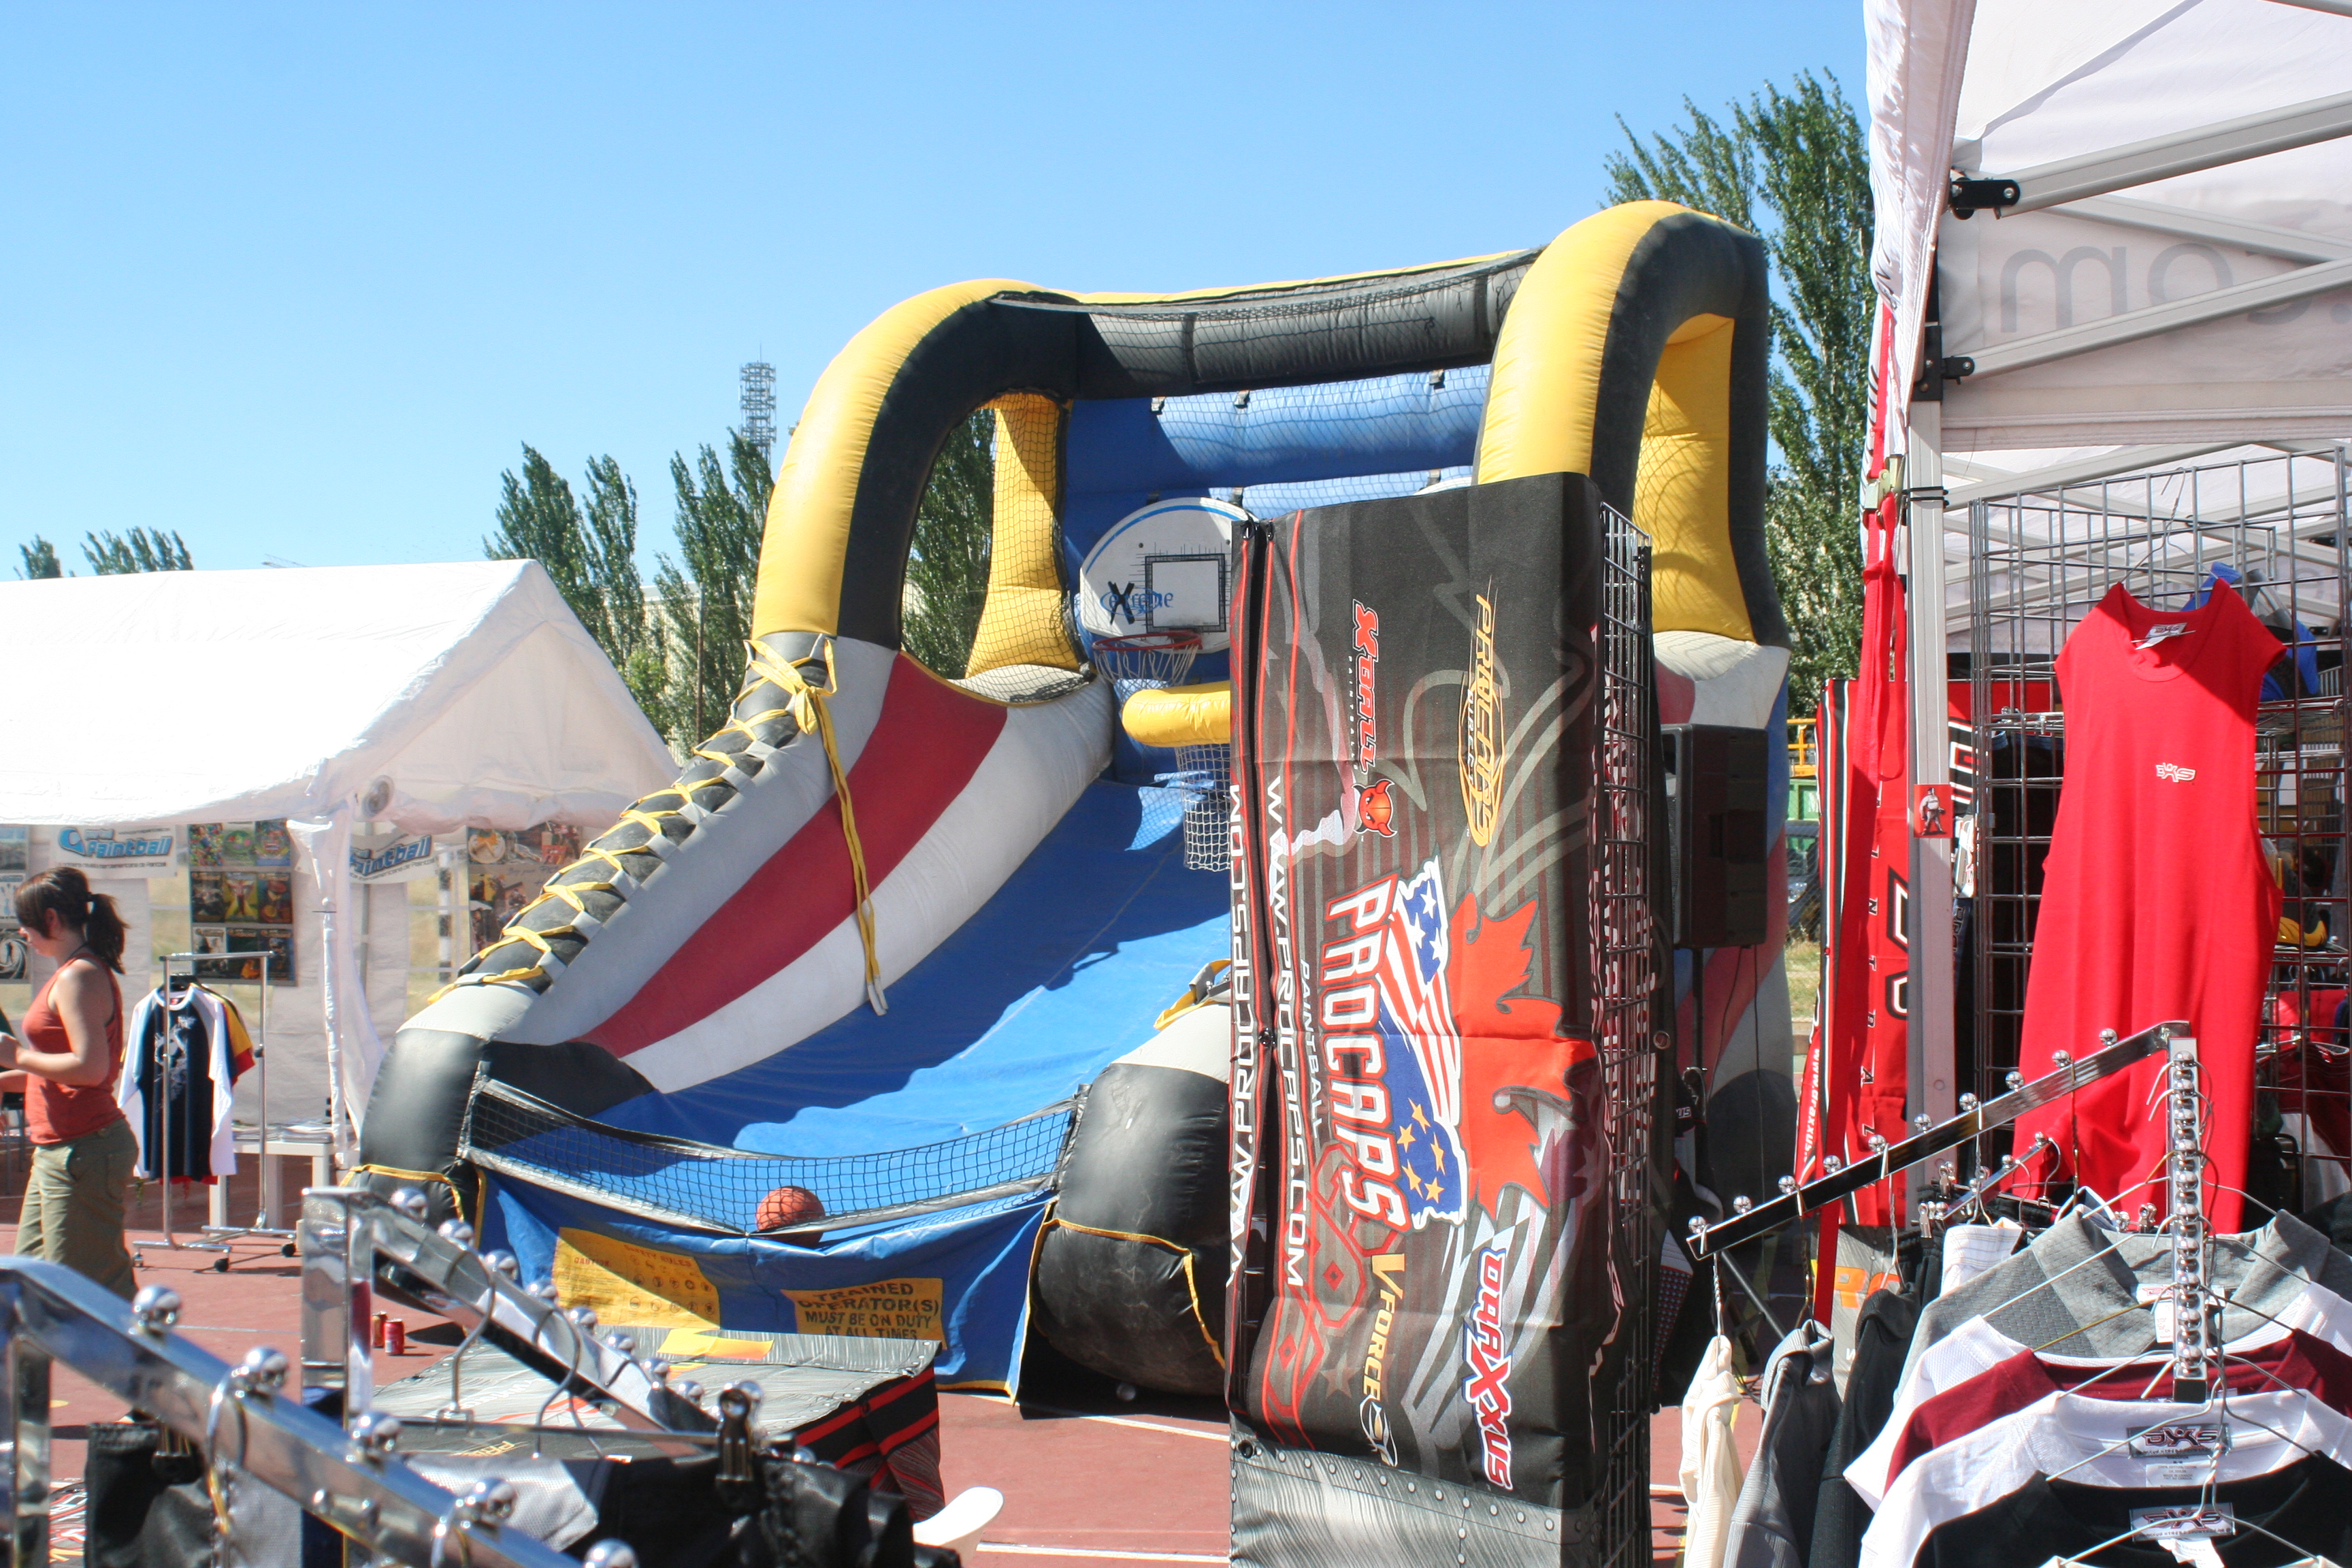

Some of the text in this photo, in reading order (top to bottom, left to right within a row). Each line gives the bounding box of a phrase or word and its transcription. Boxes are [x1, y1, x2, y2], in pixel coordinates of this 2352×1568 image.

[1352, 599, 1379, 774] XBALL
[1465, 688, 1475, 786] DIRECT
[1266, 775, 1307, 1286] WWW.PROCAPS.COM
[1299, 958, 1322, 1139] PAINTBALL
[1322, 872, 1411, 1231] PROCAPS
[798, 1297, 939, 1316] OPERATOR(S)
[804, 1311, 932, 1328] MUST BE ON DUTY
[813, 1283, 914, 1303] TRAINED
[825, 1325, 841, 1335] AT
[875, 1328, 917, 1339] TIMES
[1462, 1248, 1512, 1491] DRAXXUS
